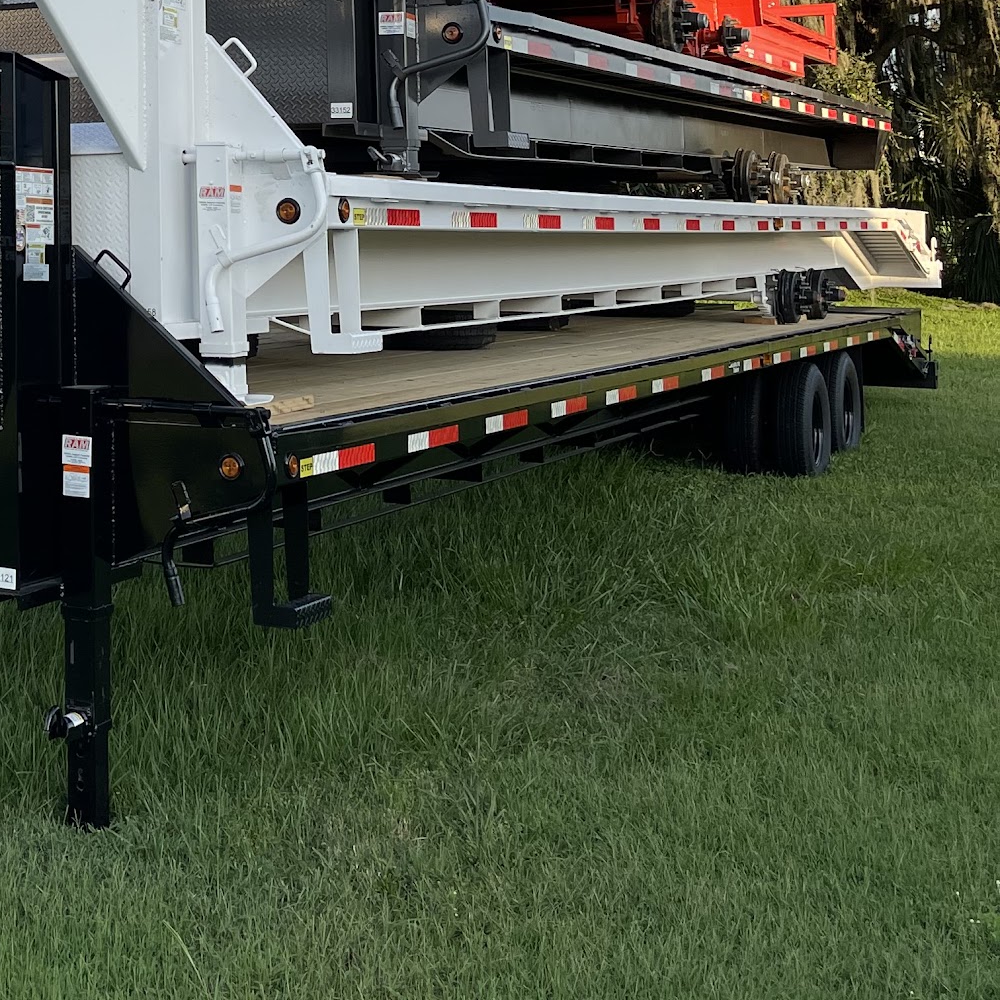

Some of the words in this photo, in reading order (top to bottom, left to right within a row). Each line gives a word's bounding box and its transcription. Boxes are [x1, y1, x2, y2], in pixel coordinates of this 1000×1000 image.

[380, 13, 403, 23] RAM
[331, 106, 351, 114] 33152
[199, 186, 225, 199] RAM
[64, 436, 90, 451] RAM
[301, 463, 313, 473] STEP
